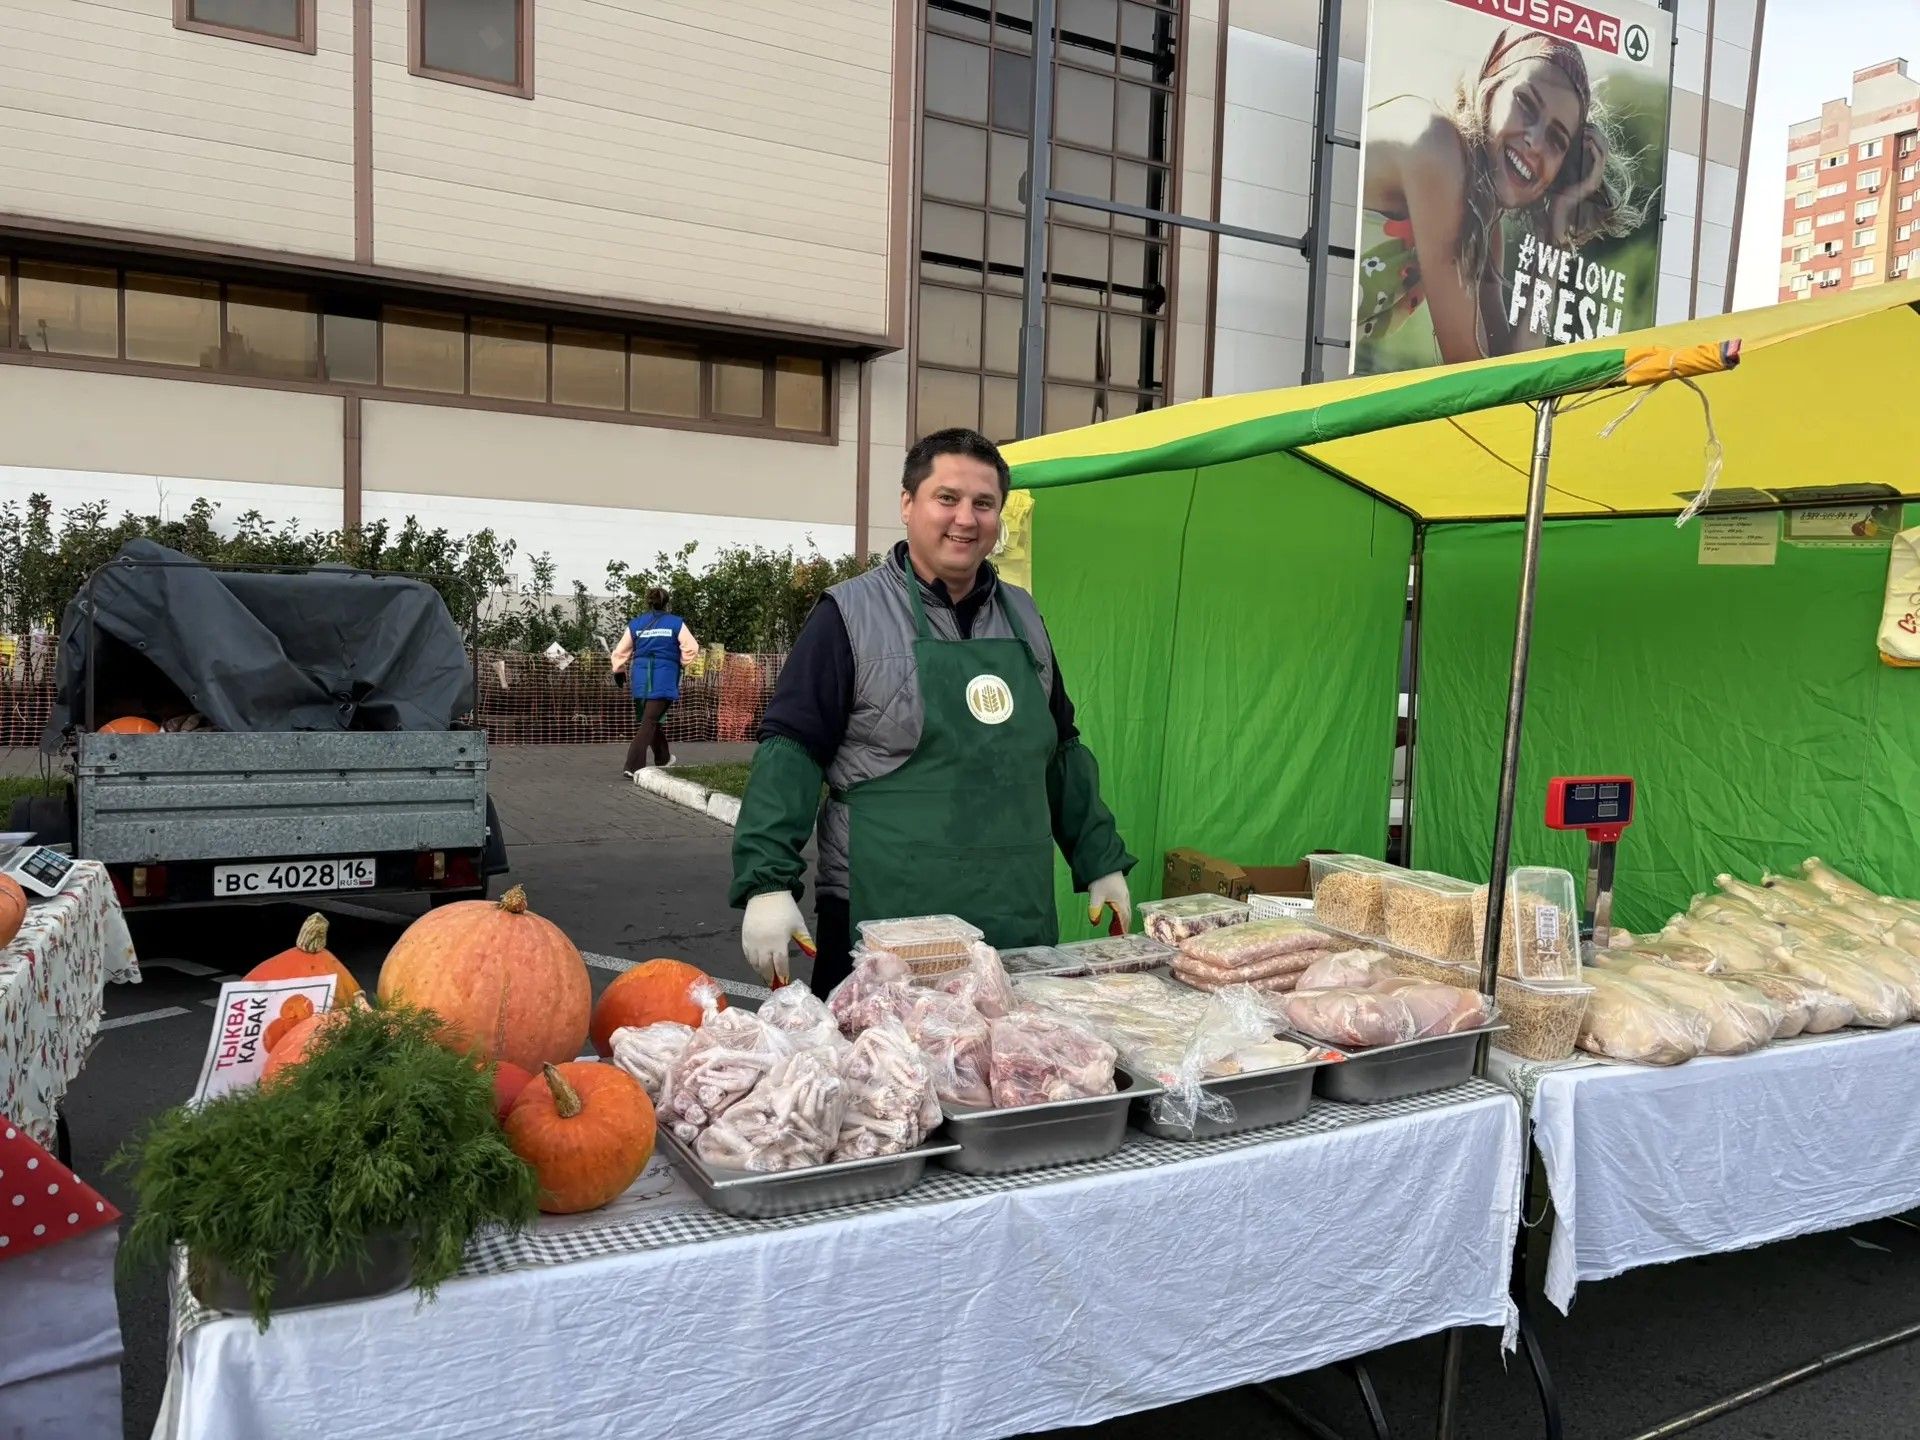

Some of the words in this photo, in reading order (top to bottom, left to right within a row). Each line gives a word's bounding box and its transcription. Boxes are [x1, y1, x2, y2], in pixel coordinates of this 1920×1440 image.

[1518, 233, 1571, 283] #WE
[1575, 256, 1626, 304] LOVE
[1509, 270, 1622, 343] FRESH
[267, 864, 335, 889] 4028
[343, 860, 367, 878] 16
[339, 879, 359, 887] RUS
[215, 998, 249, 1071] ТЫКВА
[237, 997, 269, 1064] КАБАК
